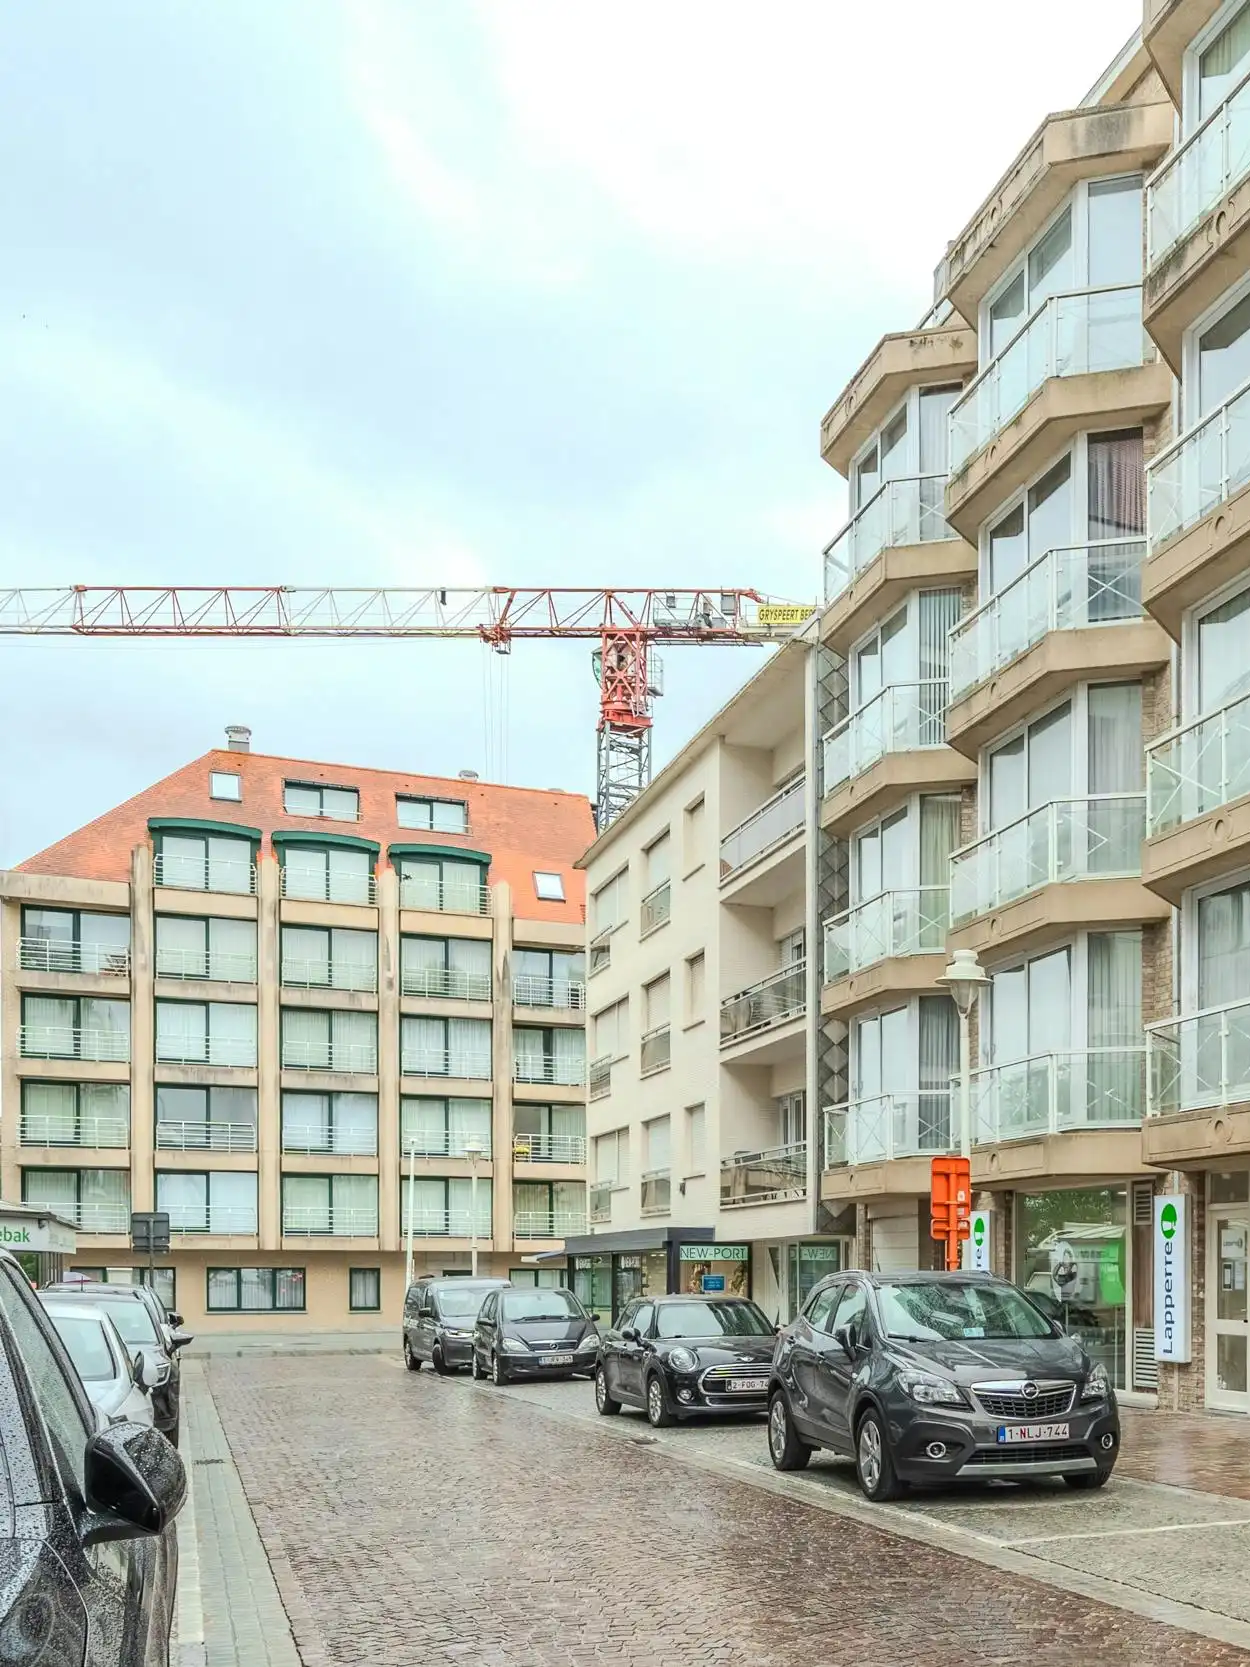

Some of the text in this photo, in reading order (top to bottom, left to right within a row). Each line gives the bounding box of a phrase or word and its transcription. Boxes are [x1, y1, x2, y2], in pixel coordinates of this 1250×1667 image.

[759, 608, 798, 620] GRYSPEERT
[0, 1226, 30, 1242] bak
[680, 1247, 746, 1259] NEW-PORT
[1163, 1241, 1175, 1355] Lapperre
[1008, 1425, 1068, 1439] 1-NLJ-744
